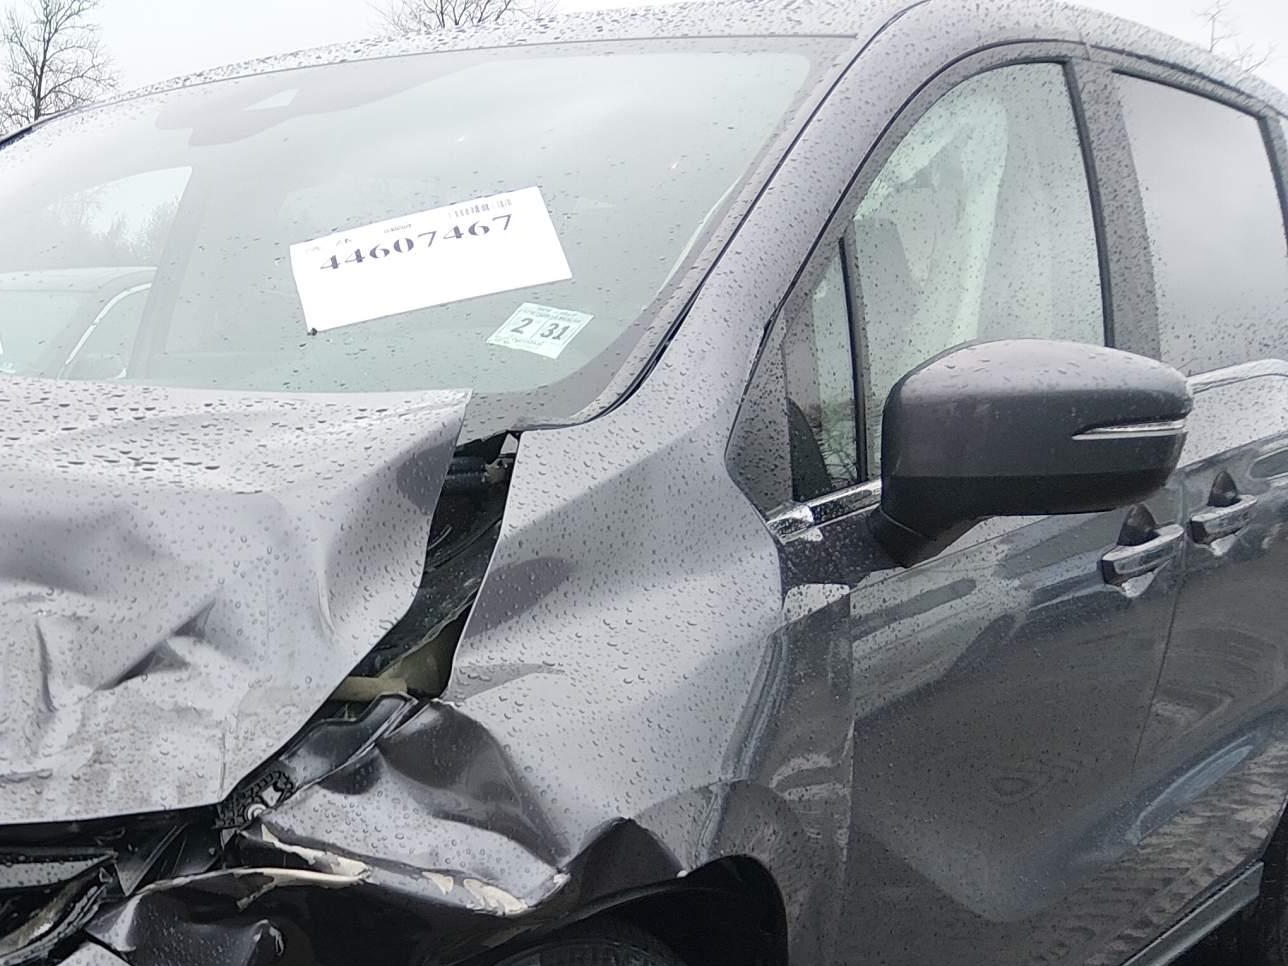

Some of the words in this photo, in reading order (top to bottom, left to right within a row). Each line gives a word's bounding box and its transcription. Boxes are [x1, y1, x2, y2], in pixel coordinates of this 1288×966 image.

[320, 214, 513, 270] 44607467
[509, 317, 534, 335] 2
[539, 322, 570, 340] 31
